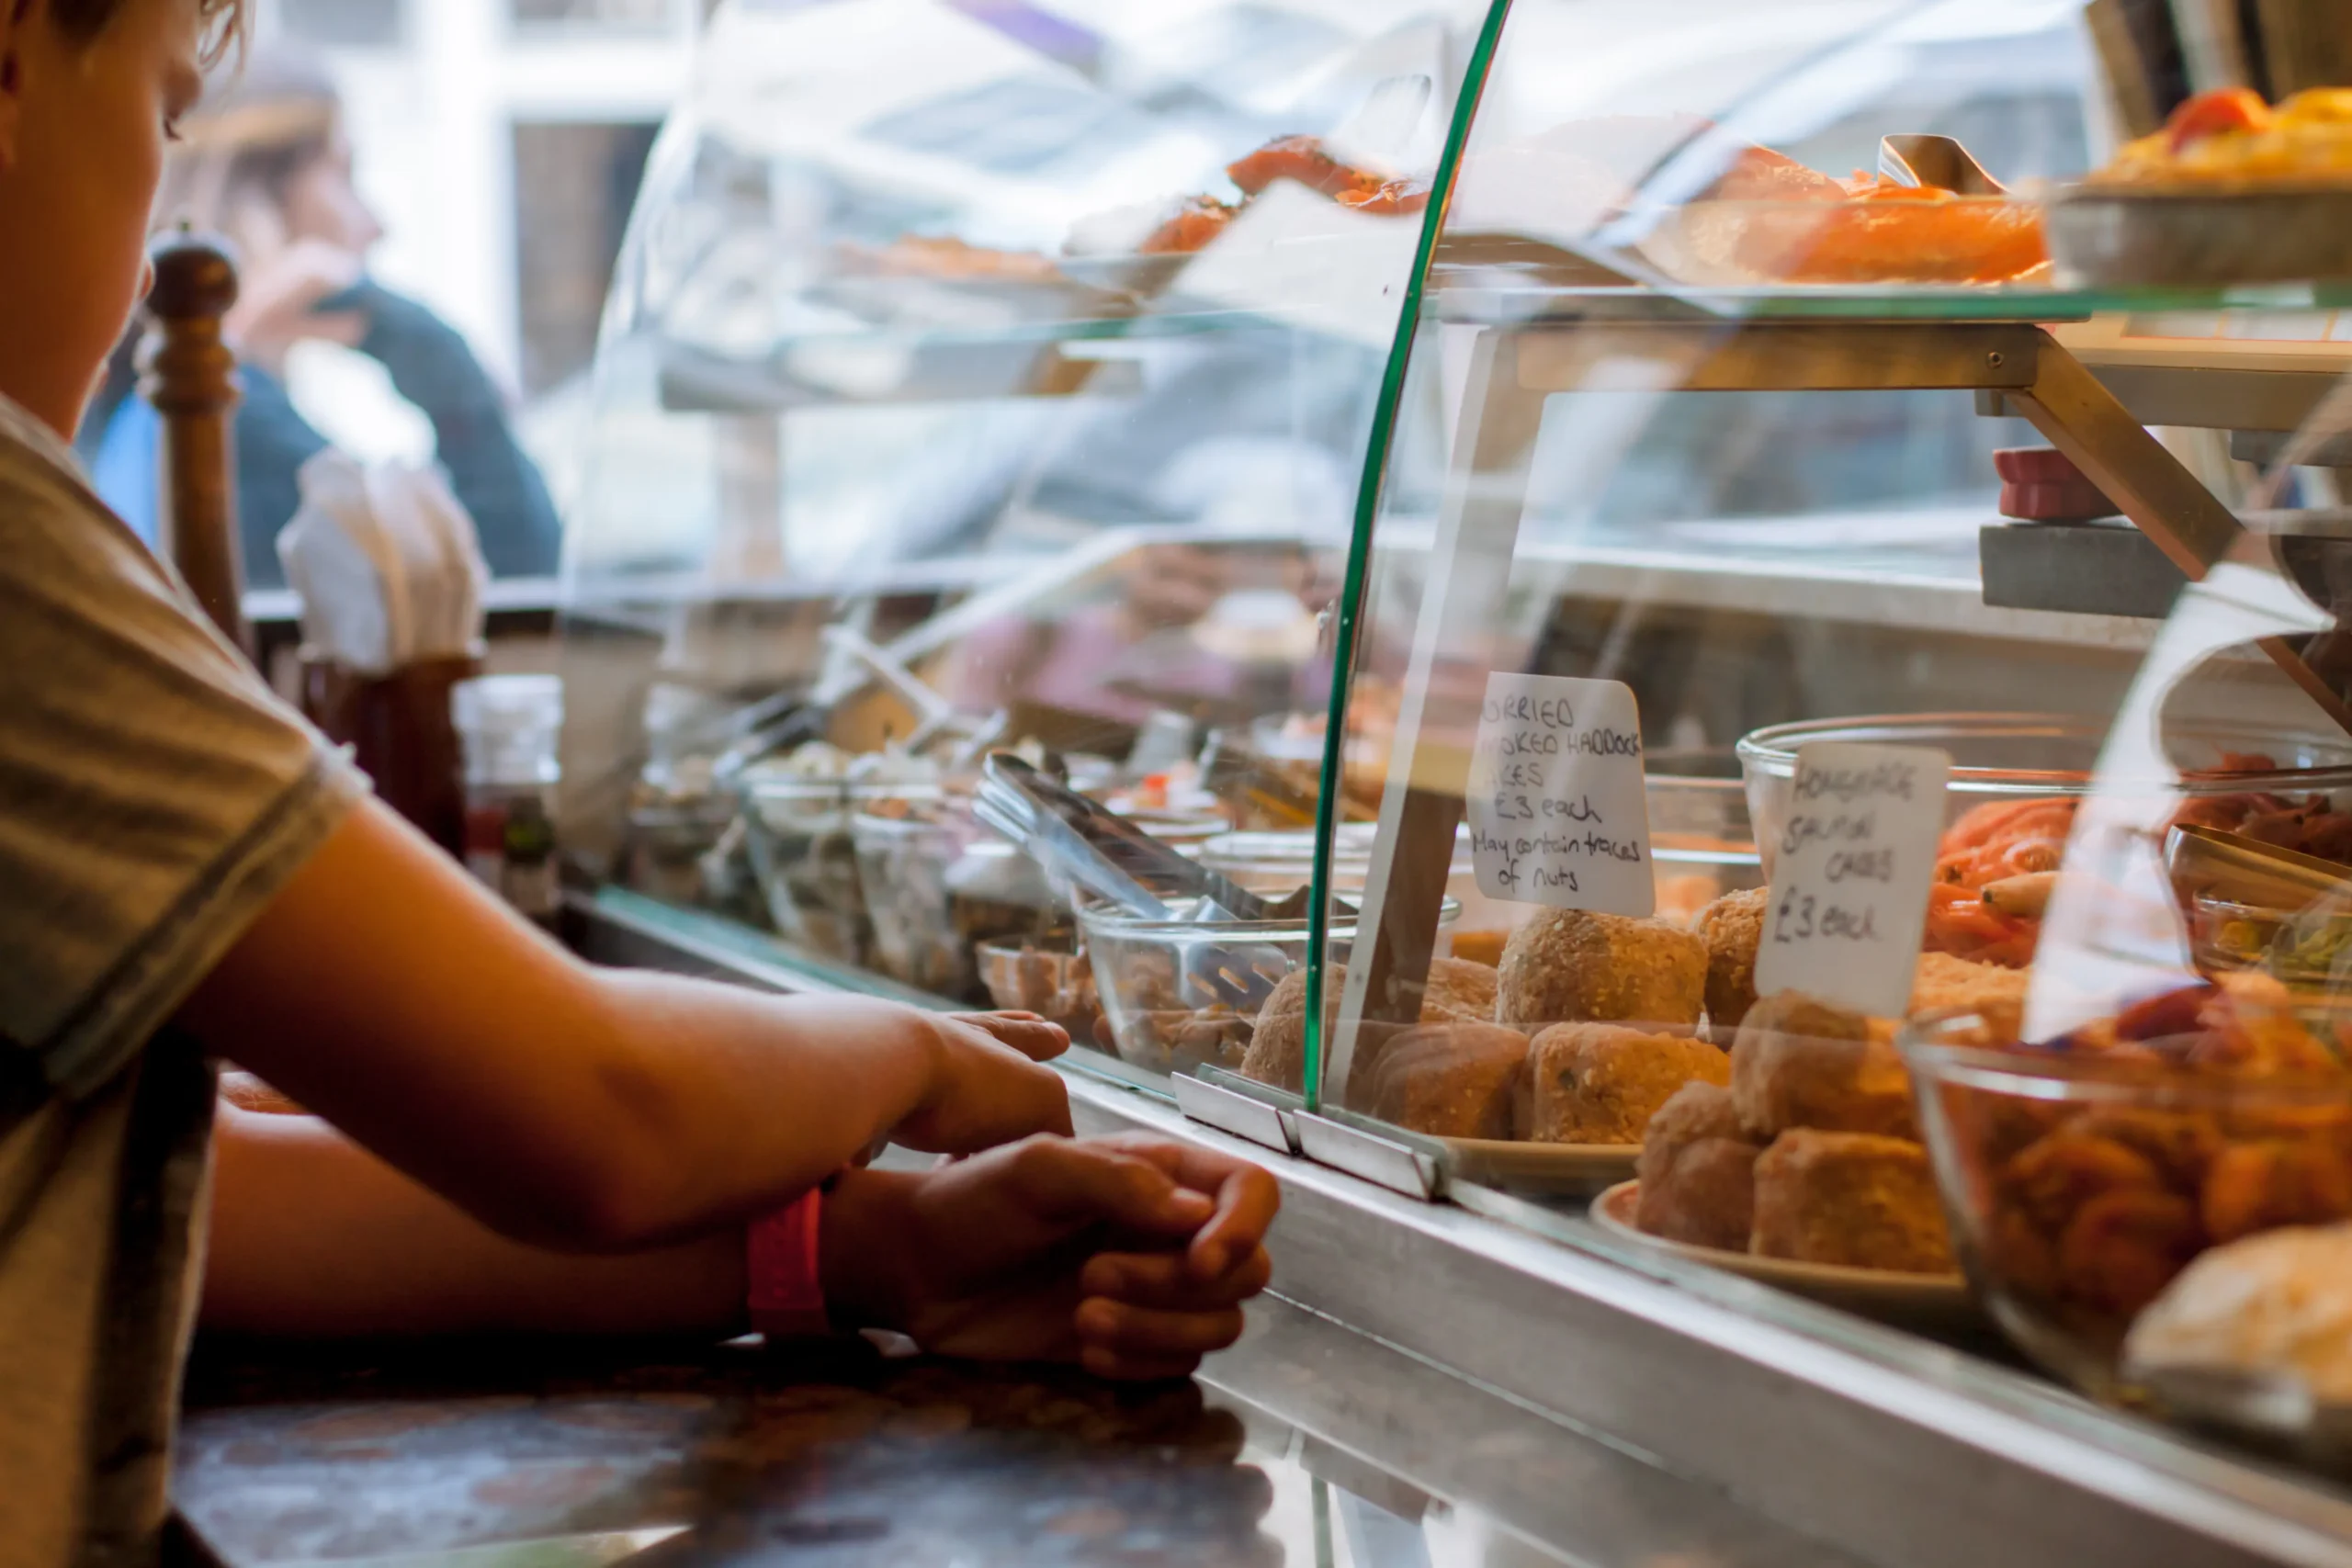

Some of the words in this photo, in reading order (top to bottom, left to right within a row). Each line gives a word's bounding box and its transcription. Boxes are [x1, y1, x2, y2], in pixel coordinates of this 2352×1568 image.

[1567, 728, 1641, 757] HADDOCK
[1543, 795, 1602, 823] each
[1473, 829, 1510, 861] May
[1516, 831, 1579, 854] contain
[1584, 831, 1640, 862] traces
[1498, 859, 1521, 894] of
[1532, 865, 1579, 892] nuts
